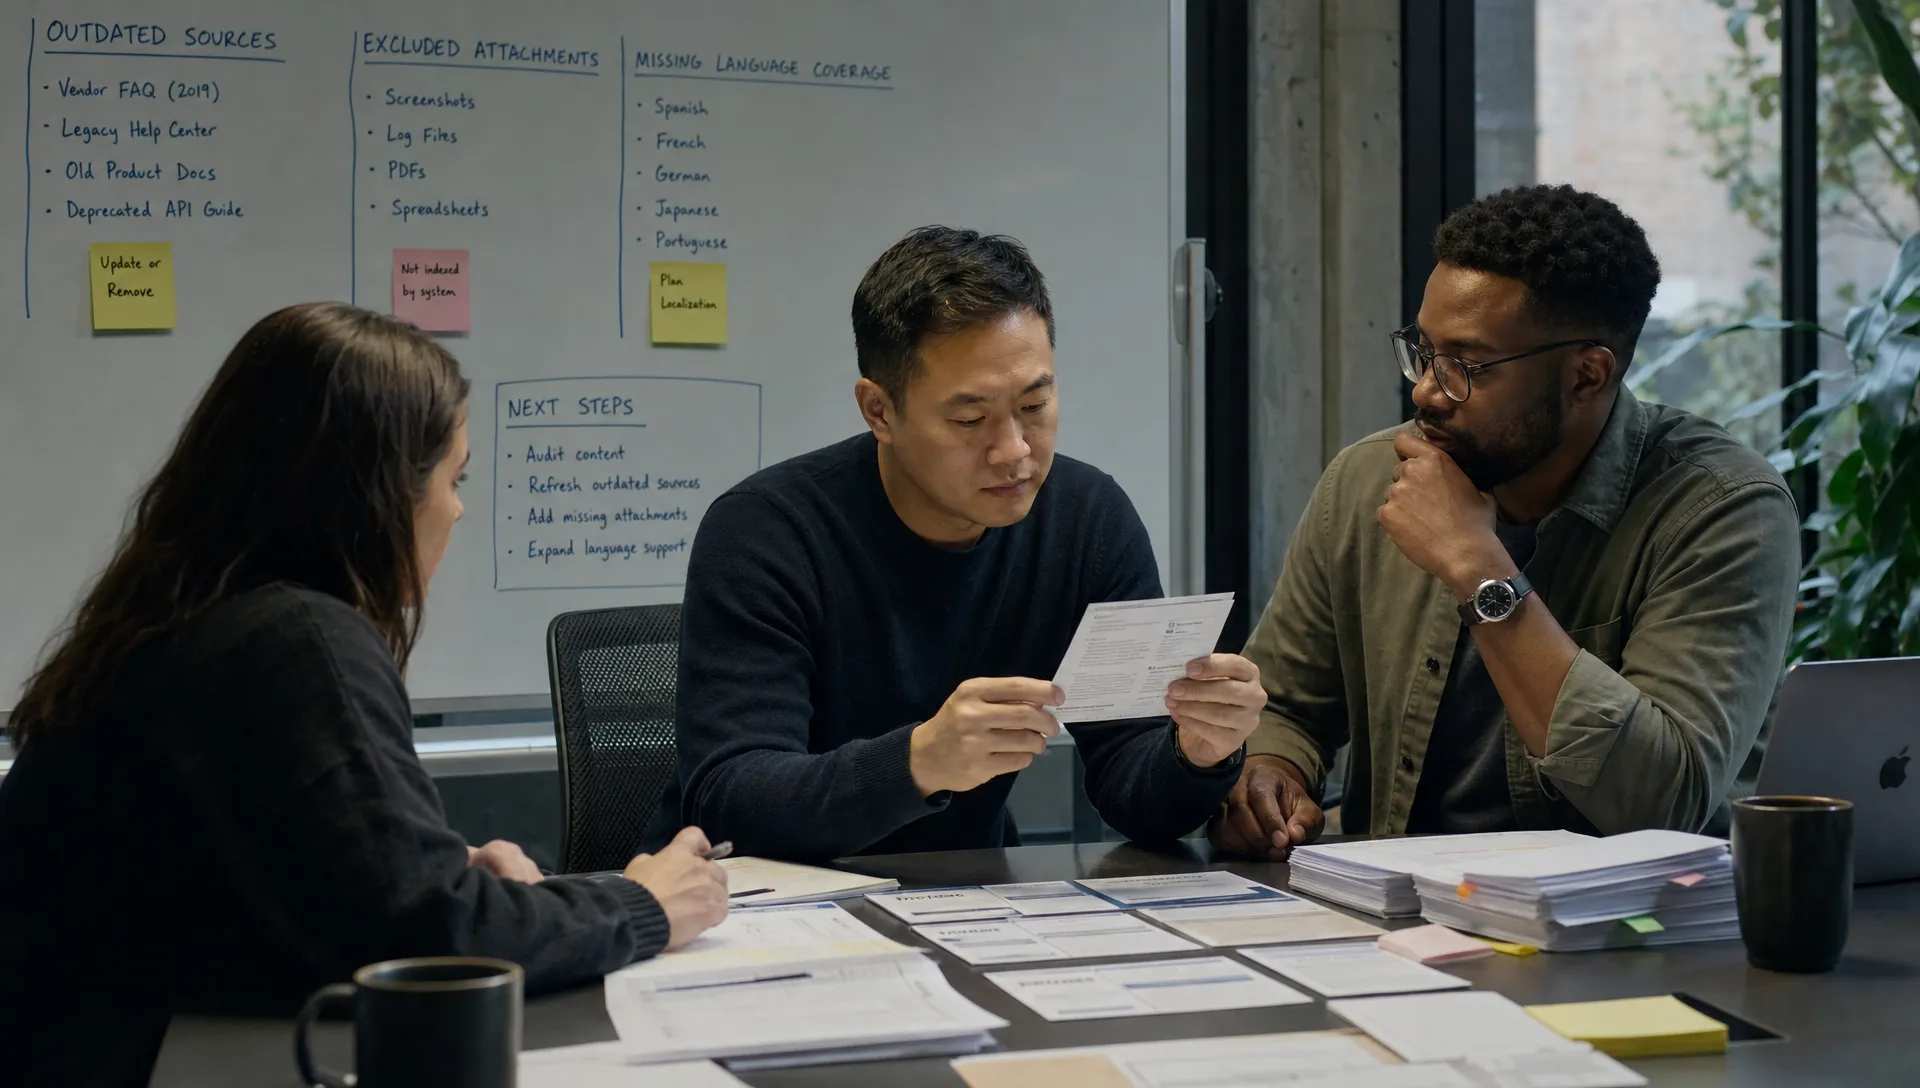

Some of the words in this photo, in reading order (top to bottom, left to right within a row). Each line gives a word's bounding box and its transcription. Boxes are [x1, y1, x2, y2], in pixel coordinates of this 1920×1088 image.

[46, 19, 167, 46] OUTDATED
[184, 26, 277, 51] SOURCES
[363, 31, 461, 58] EXCLUDED
[473, 40, 599, 68] ATTACHMENTS
[635, 51, 703, 70] MISSING
[715, 53, 799, 76] LANGUAGE
[812, 61, 891, 82] COVERAGE
[58, 77, 108, 98] Vendor
[119, 80, 157, 100] FAQ
[167, 79, 220, 104] (2019)
[385, 87, 476, 110] Screenshots
[654, 96, 709, 120] Spanish
[61, 117, 119, 145] Legacy
[129, 119, 162, 145] Help
[168, 120, 217, 138] Center
[386, 123, 412, 149] Log
[423, 127, 458, 144] Files
[656, 131, 706, 150] French
[65, 160, 95, 180] Old
[105, 159, 163, 180] Product
[176, 161, 217, 182] Docs
[388, 159, 427, 180] PDFs
[655, 164, 711, 183] German
[66, 199, 152, 225] Deprecated
[165, 199, 192, 218] API
[203, 200, 245, 218] Guide
[391, 198, 489, 224] Spreadsheets
[655, 199, 719, 223] Japanese
[655, 229, 728, 256] Portuguese
[100, 255, 143, 276] Update
[148, 259, 162, 269] or
[401, 262, 420, 275] Not
[107, 281, 155, 299] Remove
[660, 272, 684, 287] Plan
[402, 283, 416, 302] by
[420, 285, 457, 301] system
[660, 295, 718, 310] Localization
[508, 397, 560, 419] NEXT
[578, 395, 634, 416] STEPS
[525, 444, 565, 464] Audit
[575, 444, 626, 462] content
[528, 475, 582, 495] Refresh
[592, 473, 650, 492] outdated
[656, 477, 701, 491] sources
[527, 507, 554, 526] Add
[562, 507, 608, 531] missing
[614, 506, 688, 523] attachments
[527, 538, 575, 565] Expand
[584, 538, 637, 563] language
[643, 537, 688, 560] support
